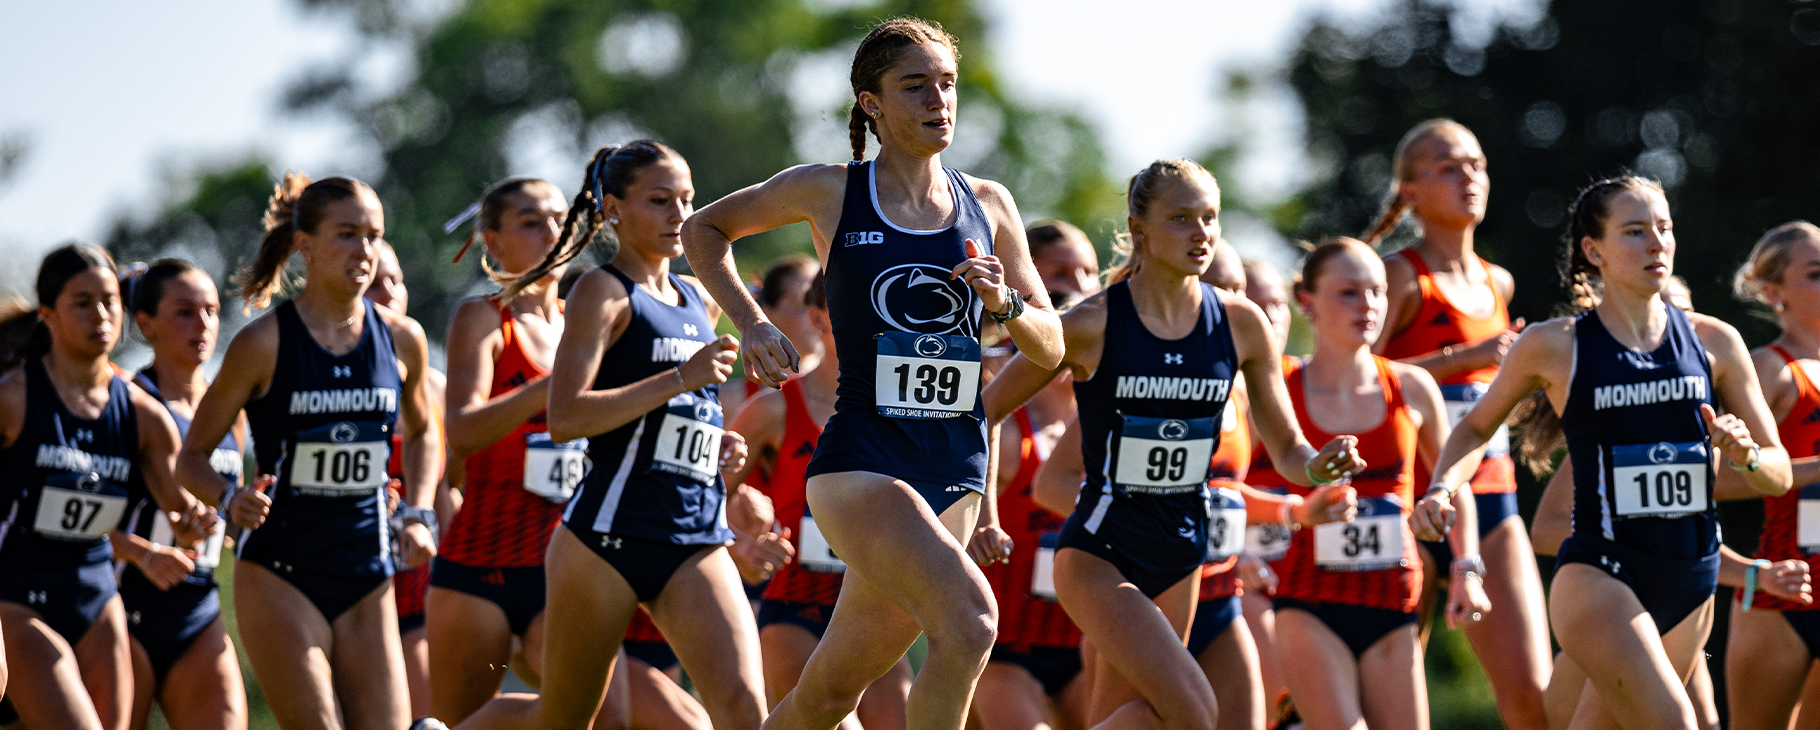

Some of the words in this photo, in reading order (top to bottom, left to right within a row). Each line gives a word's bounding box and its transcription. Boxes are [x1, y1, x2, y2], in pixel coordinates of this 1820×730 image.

[290, 387, 397, 415] MONMOUTH
[894, 363, 962, 406] 139
[1115, 375, 1230, 402] MONMOUTH
[1594, 375, 1706, 411] MONMOUTH
[886, 407, 906, 416] SPIKED
[906, 409, 922, 418] SHOE
[674, 424, 713, 468] 104
[312, 449, 371, 484] 106
[1146, 446, 1188, 482] 99
[1633, 470, 1692, 508] 109
[61, 498, 103, 532] 97
[1344, 525, 1380, 557] 34
